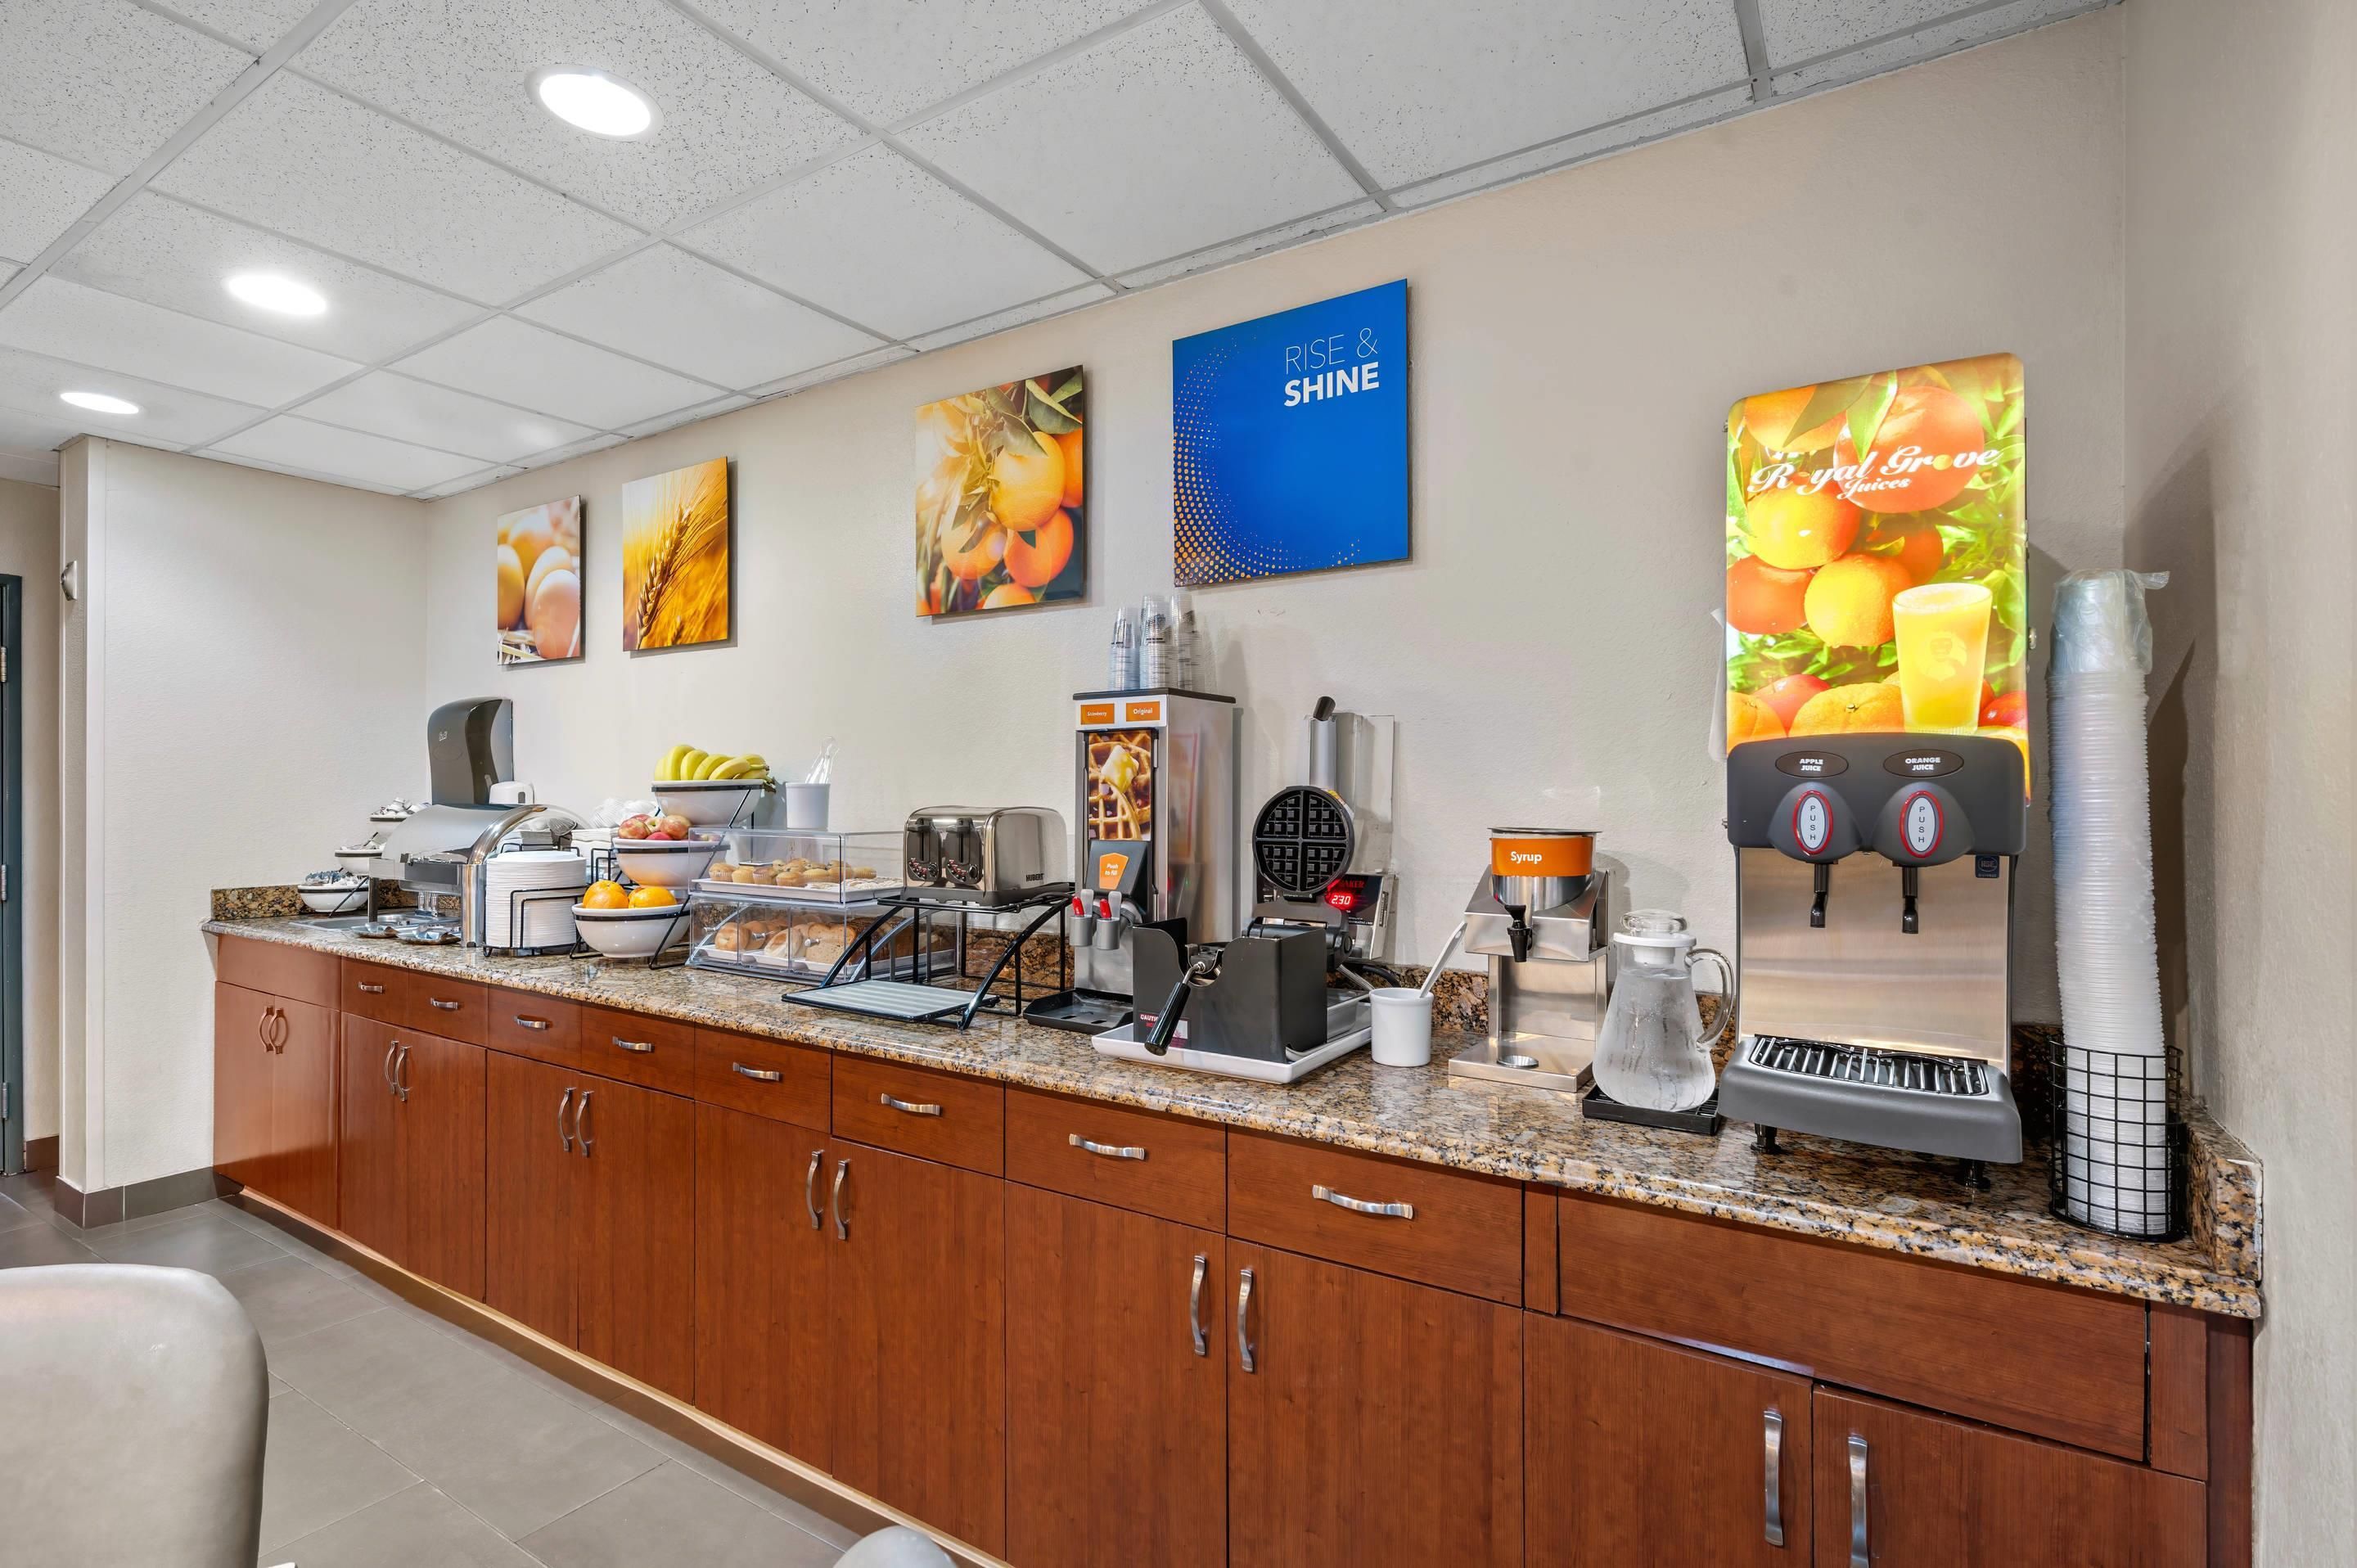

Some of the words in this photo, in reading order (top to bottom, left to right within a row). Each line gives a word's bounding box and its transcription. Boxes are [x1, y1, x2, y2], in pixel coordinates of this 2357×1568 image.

[1286, 334, 1345, 375] RISE
[1357, 327, 1378, 358] &
[1284, 362, 1379, 407] SHINE
[1836, 477, 1910, 500] Juices
[1511, 851, 1543, 864] Syrup
[1025, 873, 1044, 881] HUBERT
